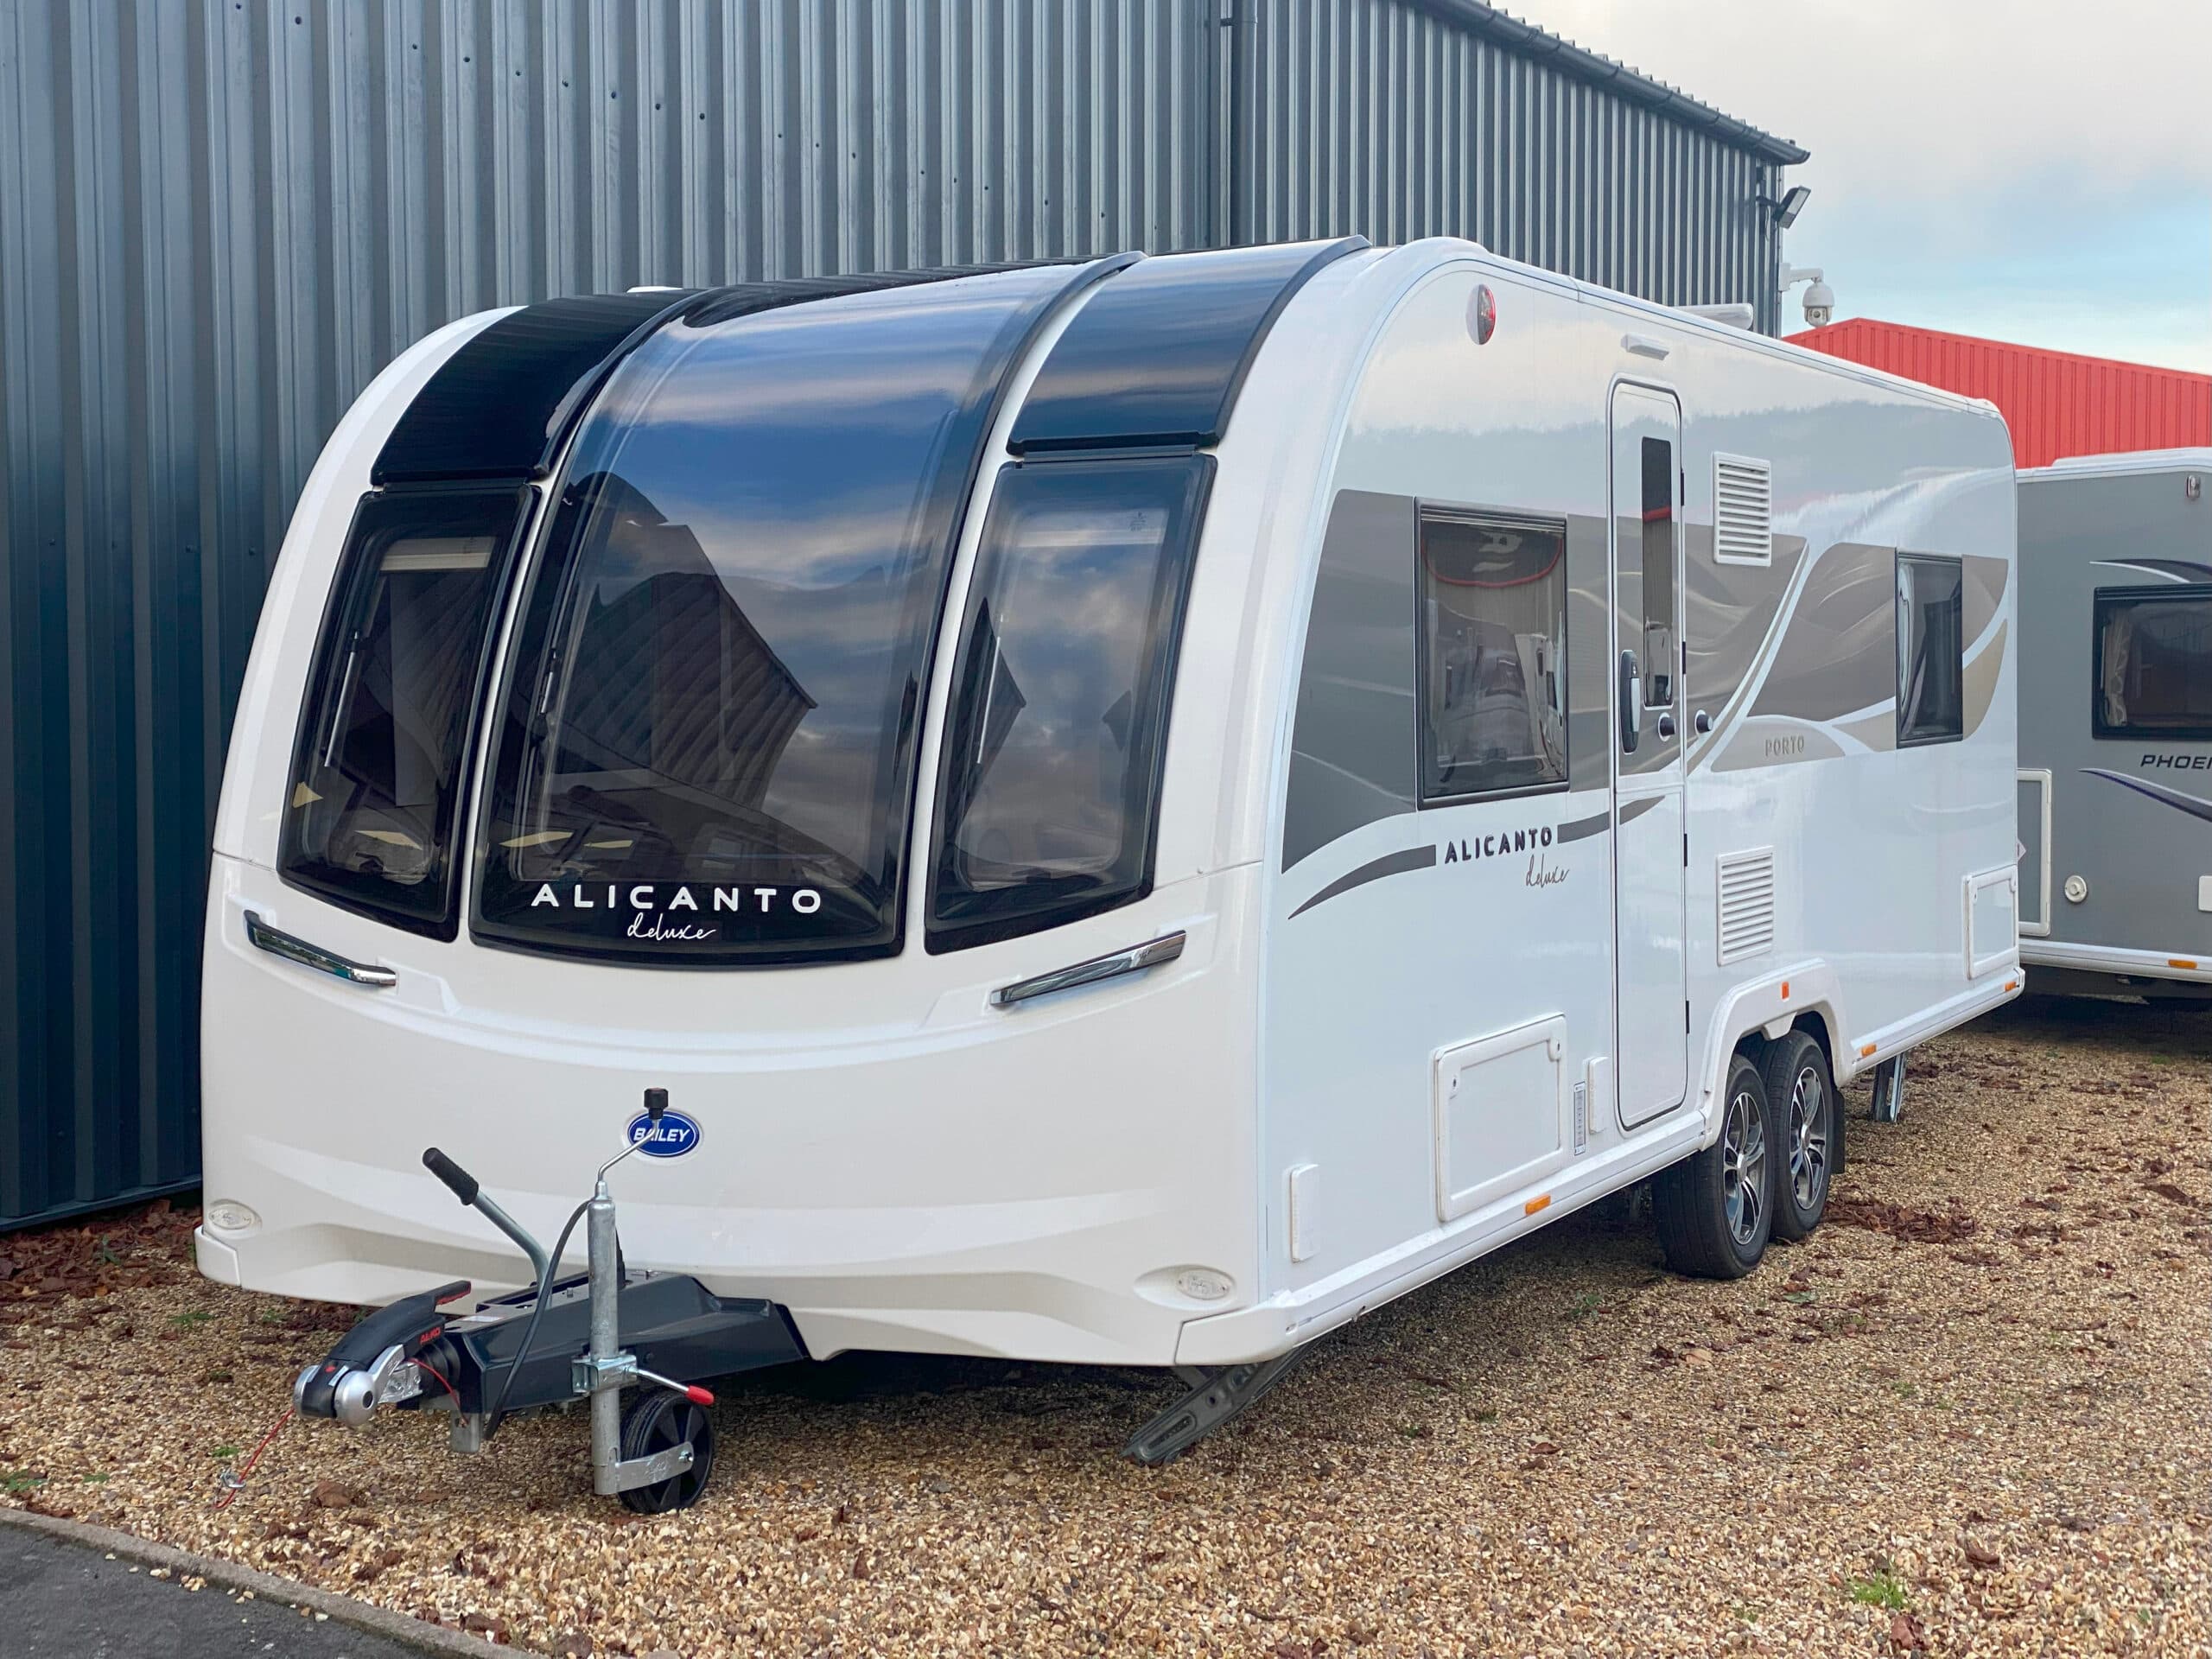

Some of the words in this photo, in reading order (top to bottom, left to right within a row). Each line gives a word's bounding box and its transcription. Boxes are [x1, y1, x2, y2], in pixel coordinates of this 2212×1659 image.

[1764, 735, 1804, 756] PORTO
[1445, 826, 1553, 864] ALICANTO
[1526, 853, 1570, 888] deluxe
[531, 884, 822, 913] ALICANTO
[626, 912, 716, 941] deluxe
